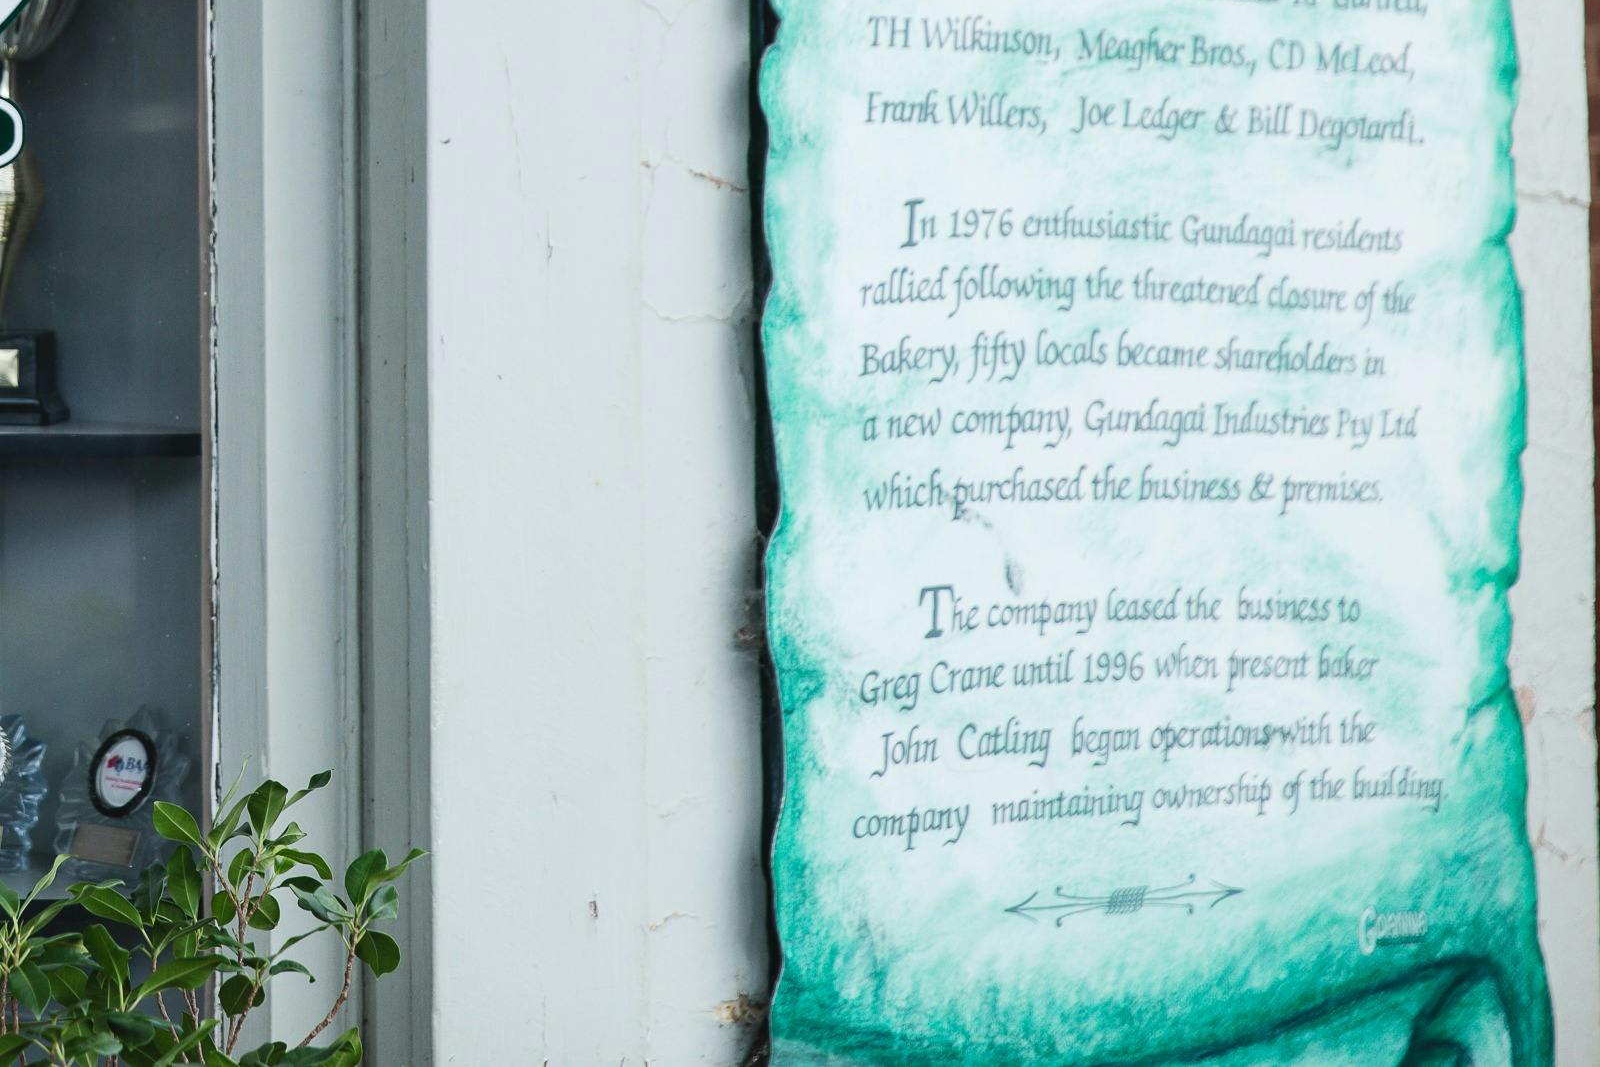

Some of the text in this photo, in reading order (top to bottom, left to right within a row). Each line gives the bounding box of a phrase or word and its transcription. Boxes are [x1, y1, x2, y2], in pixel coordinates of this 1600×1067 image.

[867, 16, 908, 49] TH
[920, 16, 1061, 65] Wilkinson,
[1076, 28, 1185, 71] Meagher
[1268, 38, 1303, 70] CD
[1316, 41, 1415, 80] McLeod,
[865, 91, 938, 124] Frank
[949, 93, 1048, 134] Willers,
[1070, 95, 1116, 134] Joe
[1122, 98, 1206, 141] Ledger
[1215, 106, 1238, 132] &
[1247, 98, 1293, 135] Bill
[900, 198, 1403, 257] In 1976 enthusiastic Gundagai residents
[860, 265, 1416, 327] rallied following the threatened closure of the
[858, 330, 1386, 383] Bakery, fifty locals became shareholders in
[862, 398, 1422, 451] a new company, Gundagai Industries Pty Ltd
[863, 464, 1384, 519] which purchased the business & premises.
[918, 584, 1361, 641] The company leased the business to
[859, 641, 1380, 710] Greg Crane until 1996 when present baker
[870, 710, 1376, 778] John Catling began operations with the
[852, 802, 970, 851] company
[991, 783, 1143, 827] maintaining
[1151, 775, 1272, 816] ownership
[1281, 777, 1304, 821] of
[1309, 766, 1345, 801] the
